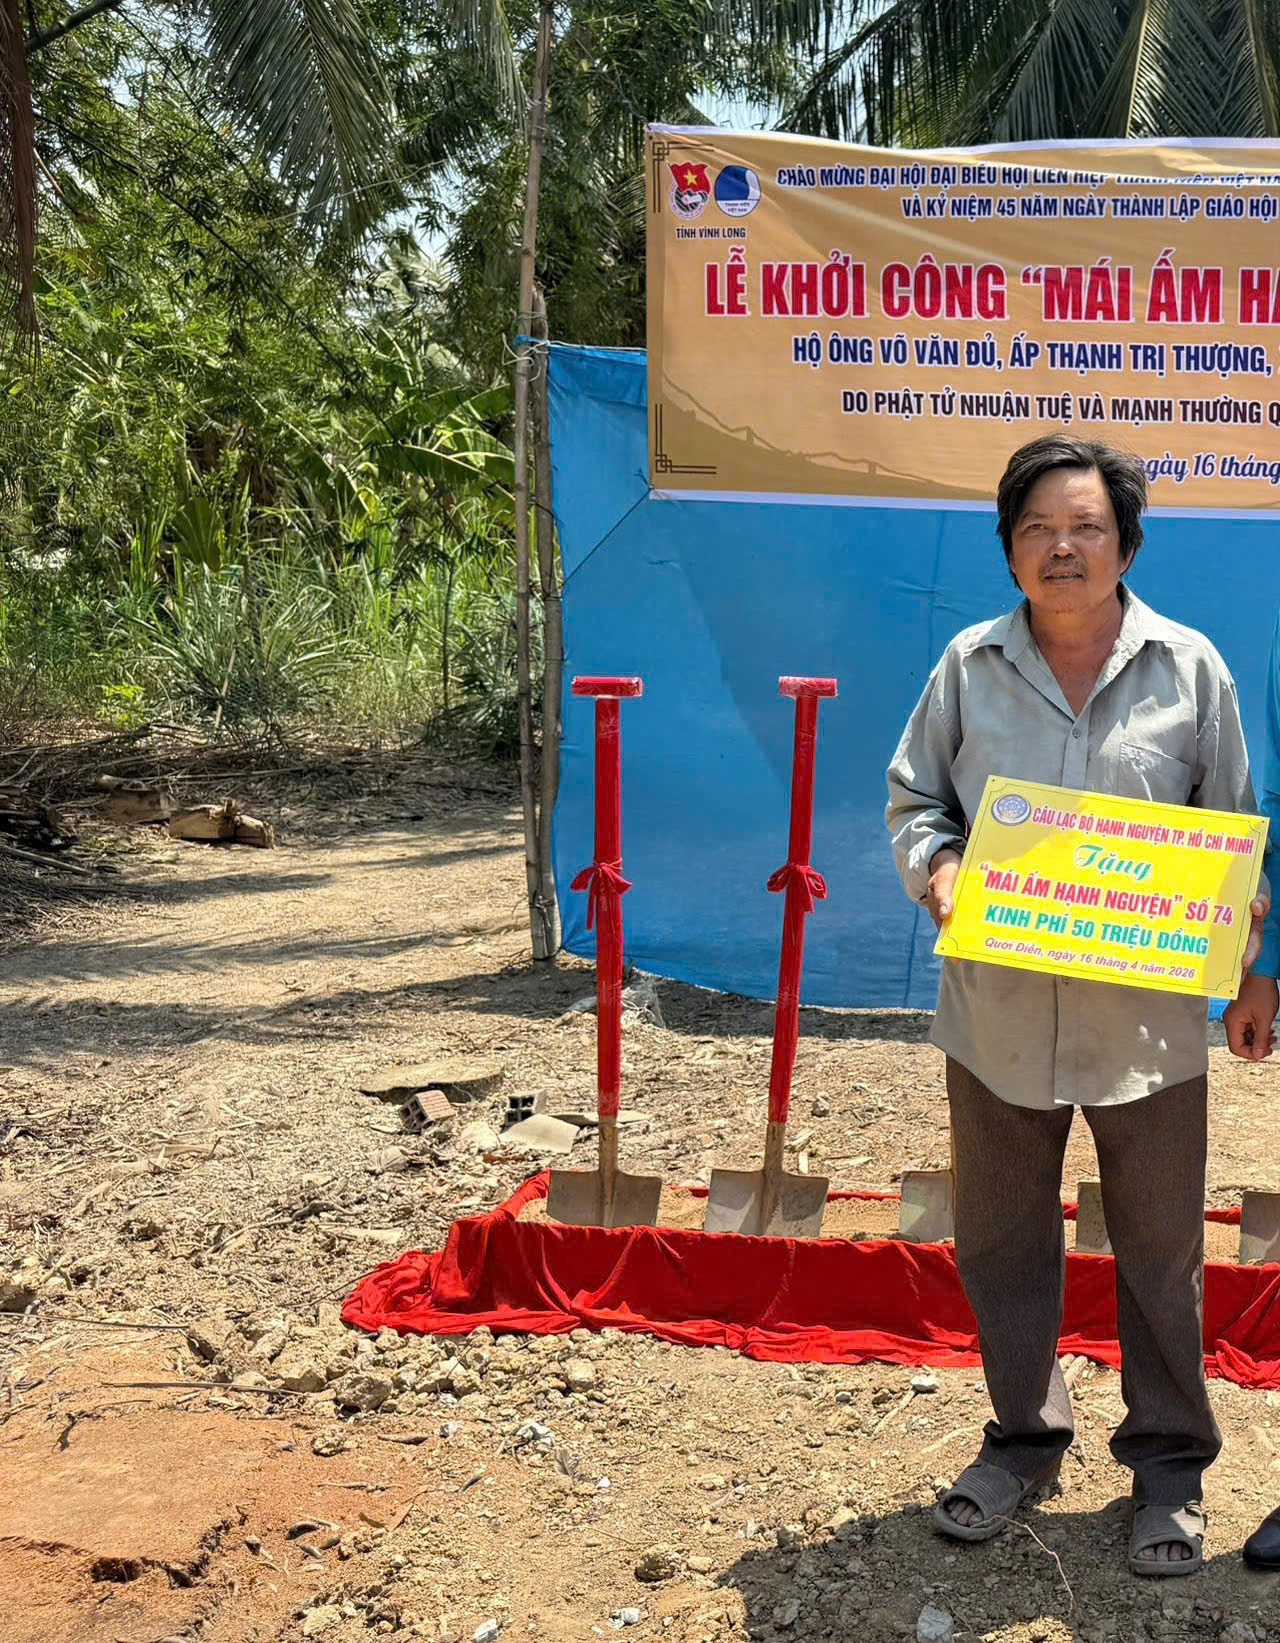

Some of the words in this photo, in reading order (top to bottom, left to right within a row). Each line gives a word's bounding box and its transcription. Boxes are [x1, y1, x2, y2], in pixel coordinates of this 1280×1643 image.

[778, 163, 816, 187] CHÀO
[820, 164, 865, 186] MỪNG
[870, 167, 895, 189] ĐẠI
[901, 164, 926, 189] HỘI
[931, 166, 957, 189] ĐẠI
[903, 196, 921, 217] VÀ
[927, 193, 947, 216] KỶ
[951, 195, 991, 221] NIỆM
[997, 198, 1016, 217] 45
[1021, 195, 1058, 217] NĂM
[1063, 195, 1107, 217] NGÀY
[1112, 195, 1164, 217] THÀNH
[1169, 194, 1200, 221] LẬP
[1206, 195, 1244, 217] GIÁO
[1250, 195, 1277, 221] HỘI
[722, 228, 746, 239] LONG
[705, 246, 748, 316] LỄ
[761, 249, 868, 318] KHỞI
[882, 253, 1008, 320] CÔNG
[1146, 248, 1223, 324] ẤM
[793, 332, 822, 367] HỘ
[829, 333, 873, 364] ÔNG
[880, 334, 908, 364] VÕ
[914, 335, 959, 366] VĂN
[965, 332, 1002, 370] ĐỦ,
[1009, 332, 1040, 368] ẤP
[1047, 342, 1122, 375] THẠNH
[1129, 344, 1165, 377] TRỊ
[1172, 343, 1272, 378] THƯỢNG,
[842, 391, 868, 413] DO
[875, 388, 924, 419] PHẬT
[930, 387, 956, 415] TỬ
[960, 391, 1030, 422] NHUẬN
[1036, 393, 1073, 423] TUỆ
[1079, 393, 1105, 420] VÀ
[1111, 399, 1173, 425] MẠNH
[1179, 396, 1261, 424] THƯỜNG
[1194, 454, 1215, 476] 16
[1032, 805, 1055, 825] CÂU
[1056, 812, 1077, 830] LẠC
[1078, 813, 1094, 834] BỘ
[1095, 817, 1125, 837] HẠNH
[1126, 822, 1170, 845] NGUYỆN
[1172, 829, 1184, 845] TP.
[1205, 832, 1224, 850] CHÍ
[1224, 837, 1254, 854] MINH
[1075, 844, 1152, 881] Tặng
[1021, 871, 1051, 898] ẤM
[1053, 881, 1101, 907] HẠNH
[1185, 897, 1210, 922] SỐ
[1212, 904, 1233, 925] 74
[984, 904, 1032, 928] KINH
[1034, 912, 1069, 934] PHÍ
[1071, 919, 1095, 938] 50
[1101, 923, 1152, 949] TRIỆU
[1156, 927, 1209, 955] ĐỒNG
[1080, 952, 1092, 964] 16
[1095, 955, 1128, 971] tháng
[1131, 960, 1138, 970] 4
[1168, 965, 1195, 978] 2026
